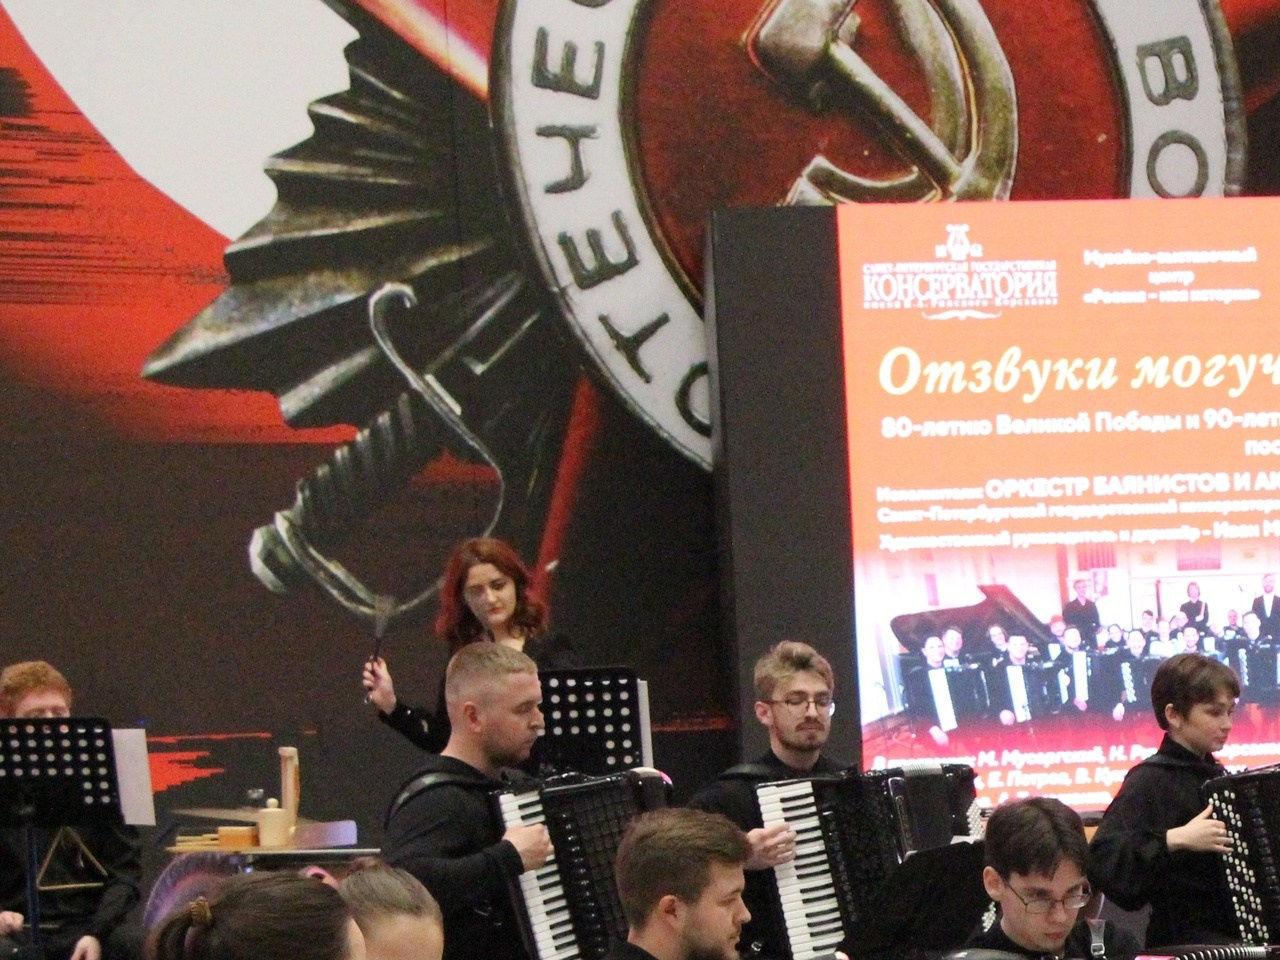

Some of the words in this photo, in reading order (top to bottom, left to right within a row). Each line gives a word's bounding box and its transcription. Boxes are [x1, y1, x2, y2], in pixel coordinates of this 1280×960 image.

[531, 0, 714, 438] ОТЕЧЕ
[863, 271, 1059, 302] КОНСЕРВАТОРИЯ
[878, 346, 1119, 404] Отзвуки
[881, 415, 993, 438] 80-летию
[996, 411, 1091, 435] Великой
[1094, 410, 1182, 433] Победы
[1185, 414, 1200, 430] и
[985, 477, 1090, 499] ОРКЕСТР
[1092, 472, 1231, 497] БАЯНИСТОВ
[1232, 471, 1252, 492] И
[1213, 520, 1261, 539] Иван
[1000, 746, 1107, 769] Мусоргский,
